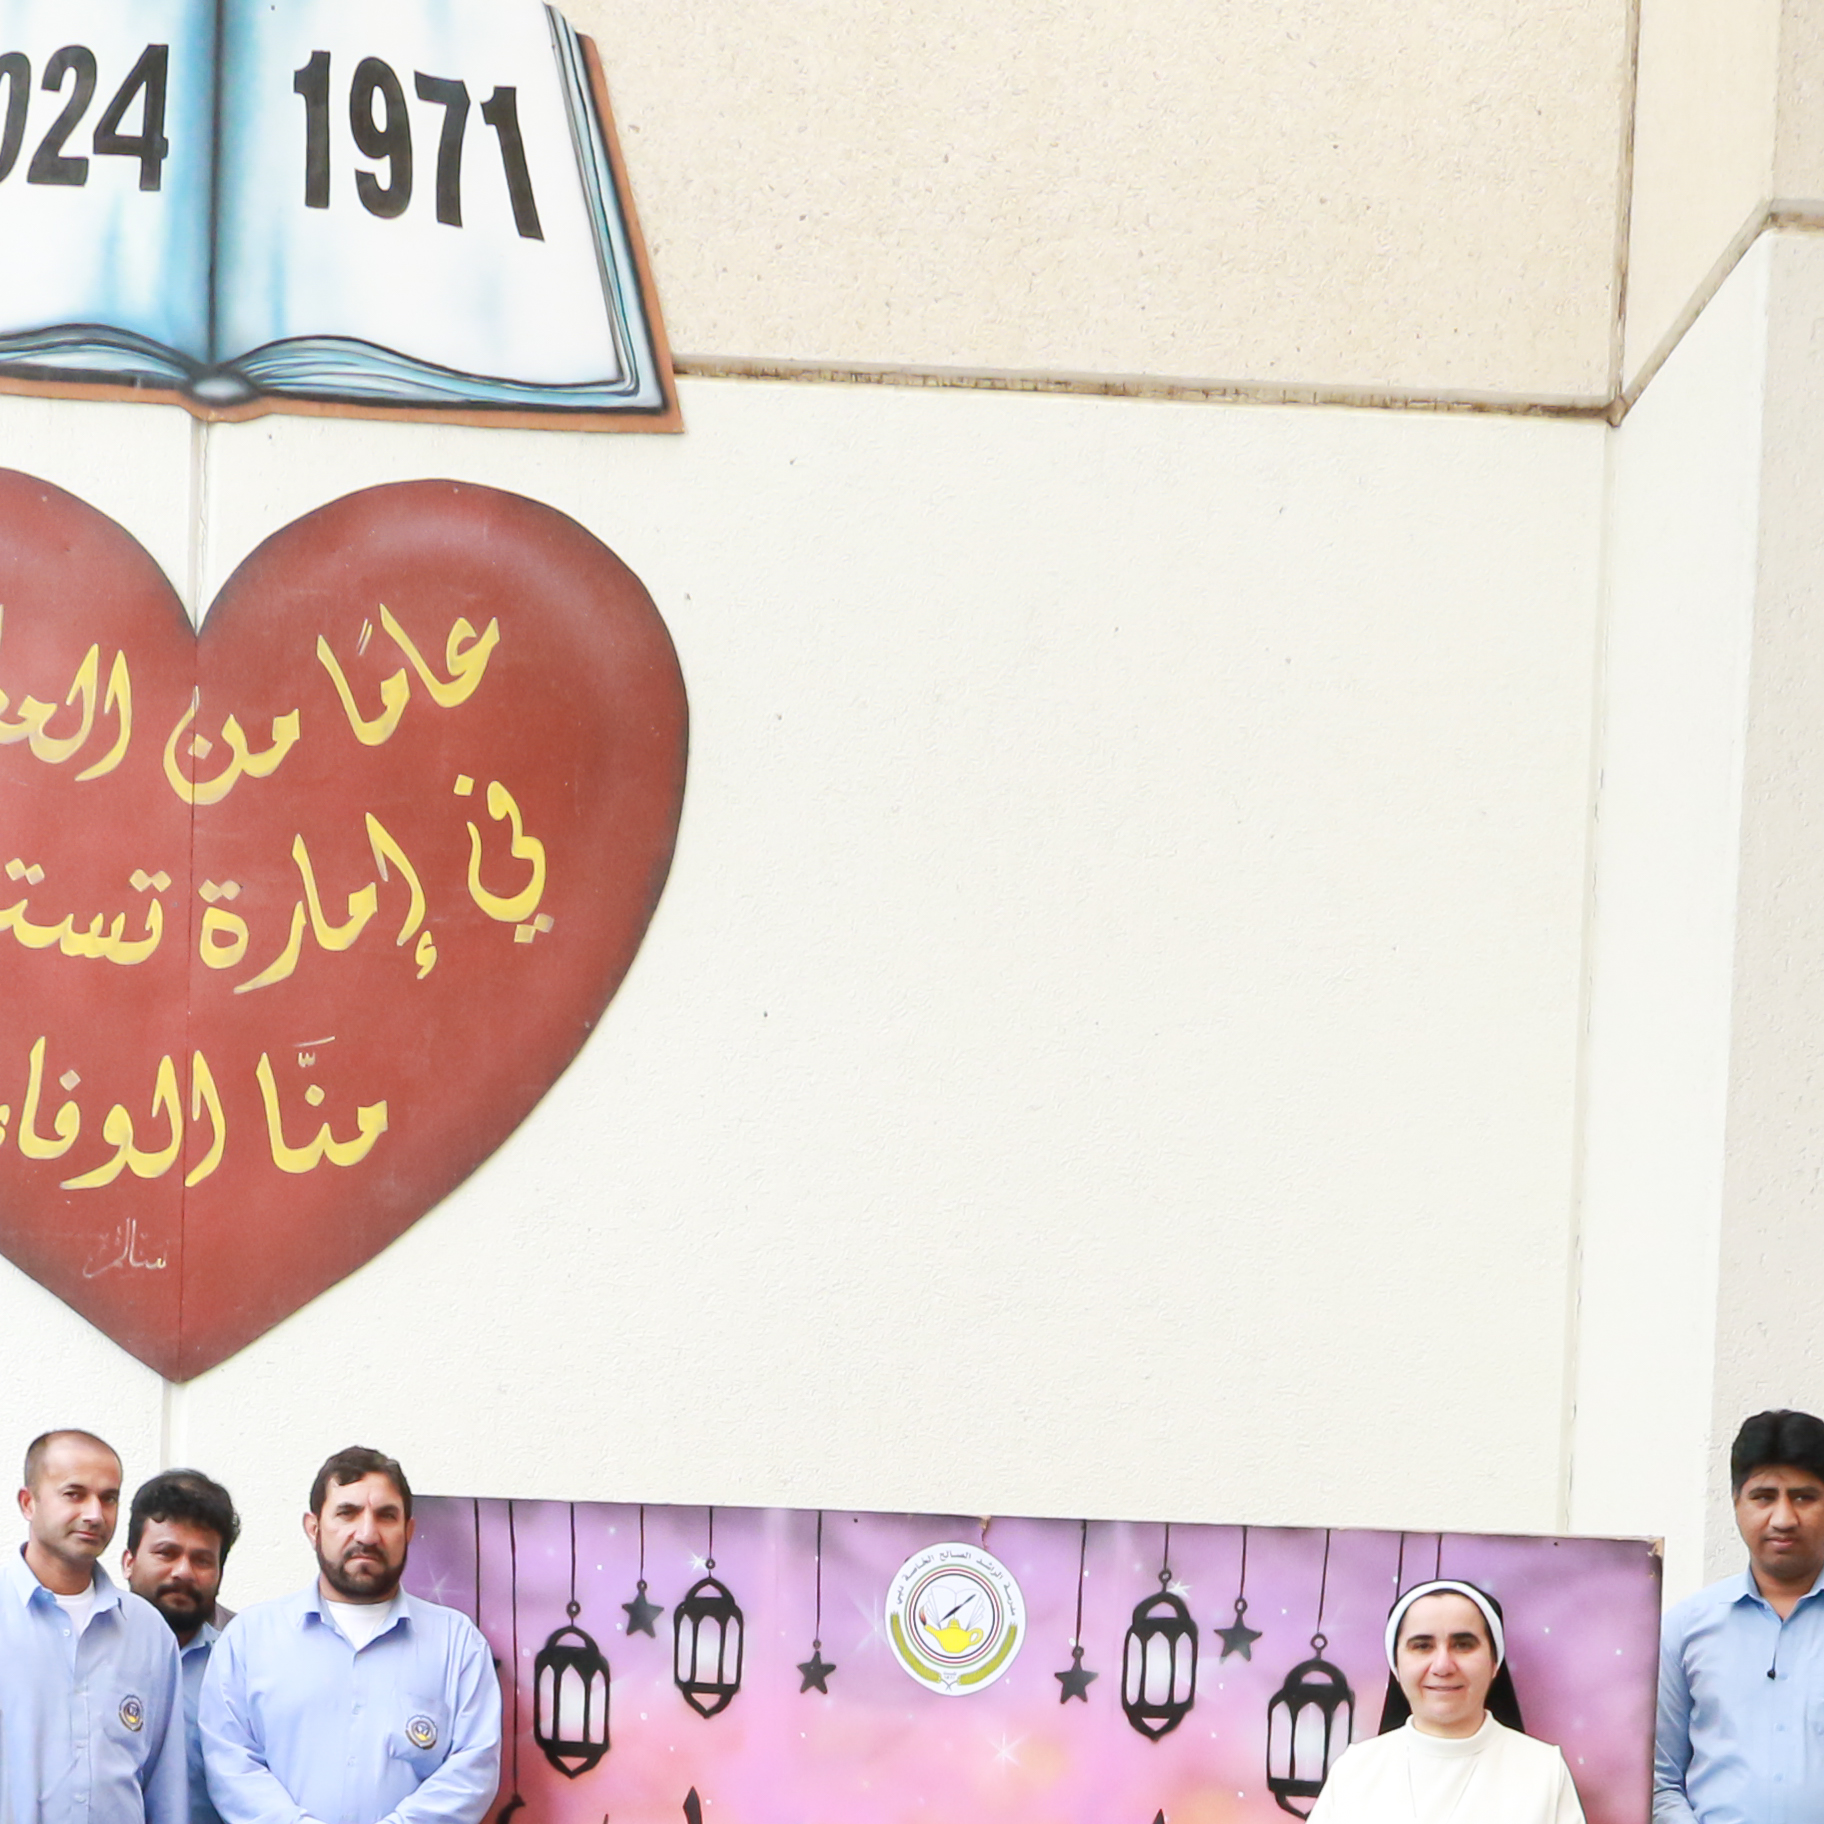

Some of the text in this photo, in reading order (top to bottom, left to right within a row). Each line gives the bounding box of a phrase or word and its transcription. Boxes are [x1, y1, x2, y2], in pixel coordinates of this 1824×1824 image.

[293, 50, 545, 243] 1971
[162, 692, 301, 805] من
[198, 813, 438, 993] إمارة
[453, 775, 552, 943] في
[902, 1555, 934, 1581] الخاصة
[939, 1550, 971, 1561] الصالح
[1003, 1582, 1015, 1616] مدرسة
